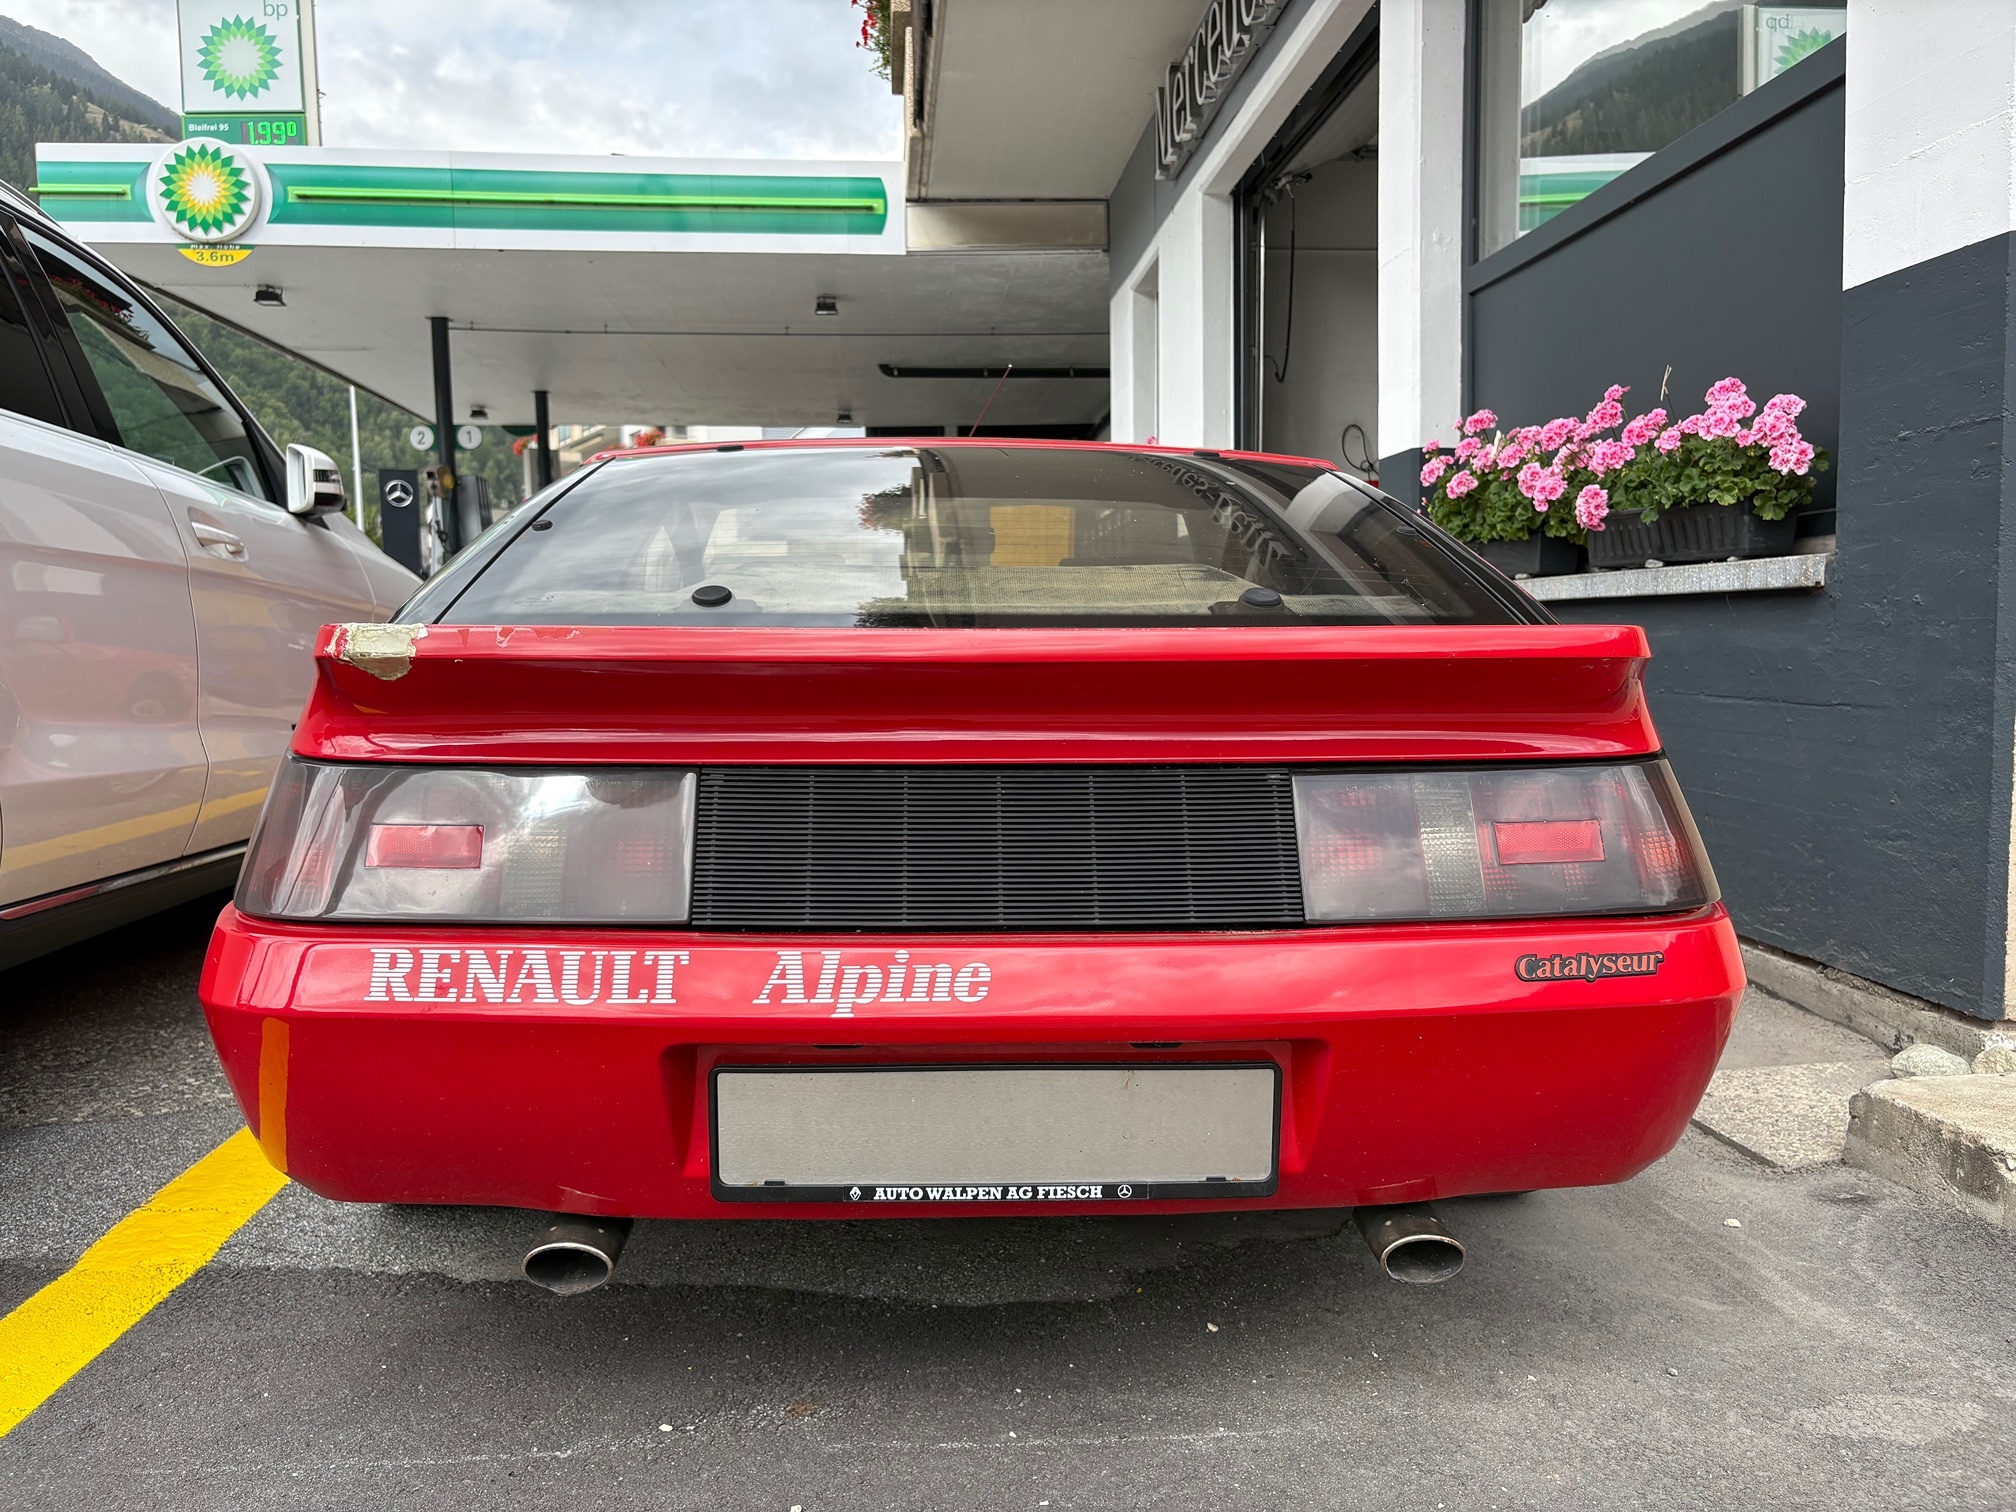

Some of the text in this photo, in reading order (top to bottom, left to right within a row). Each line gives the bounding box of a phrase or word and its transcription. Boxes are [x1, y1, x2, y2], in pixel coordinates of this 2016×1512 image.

[263, 0, 288, 20] bp
[188, 123, 229, 132] Bleifrei 95
[195, 251, 235, 262] 3.6m
[417, 431, 426, 445] 2
[466, 430, 473, 444] 1
[1517, 952, 1664, 980] Catalyseur
[364, 948, 992, 1019] RENAULT Alpine
[873, 1185, 1103, 1201] AUTO WALPEN AG FIESCH
